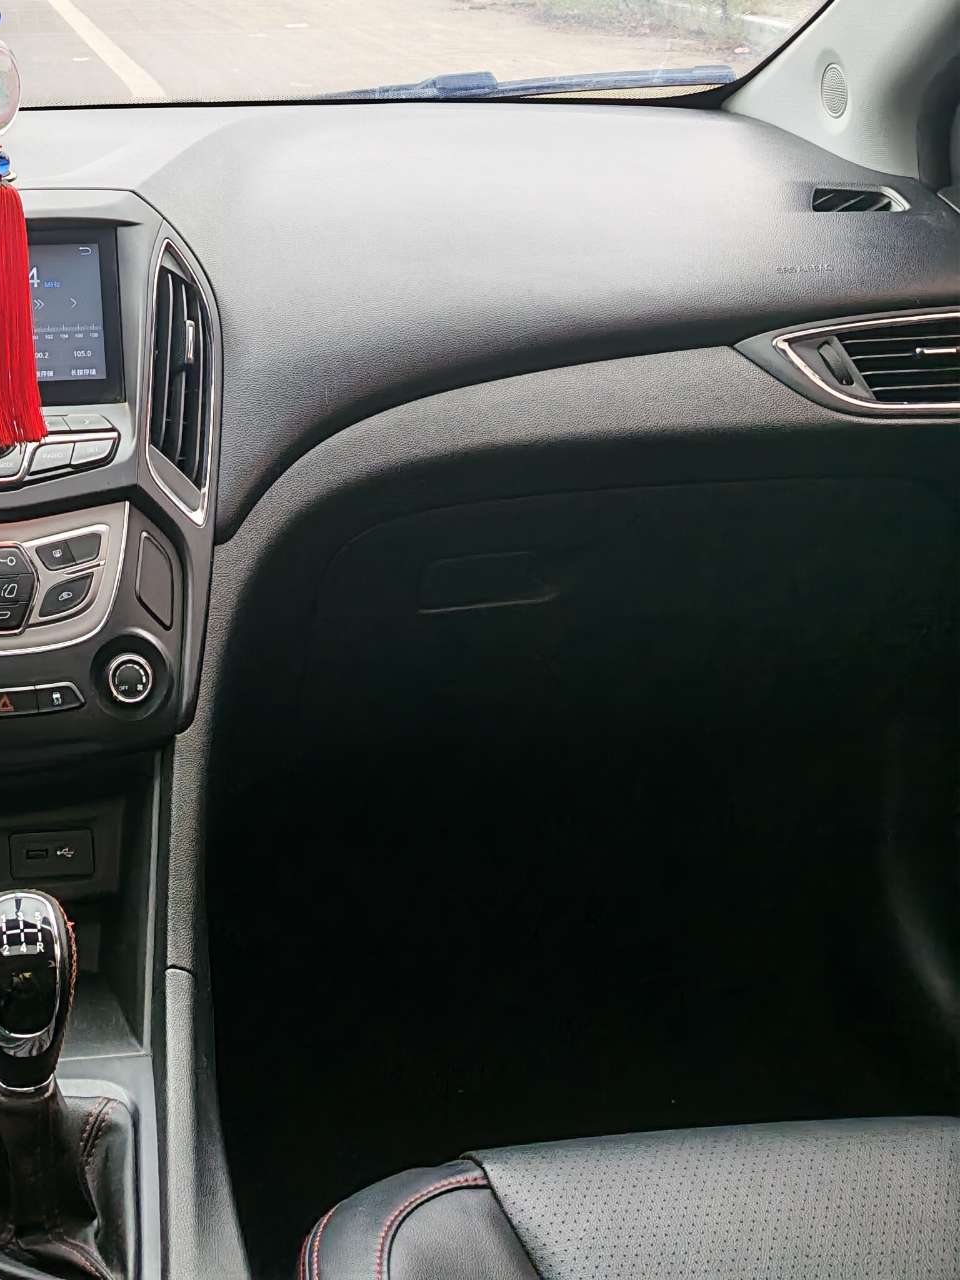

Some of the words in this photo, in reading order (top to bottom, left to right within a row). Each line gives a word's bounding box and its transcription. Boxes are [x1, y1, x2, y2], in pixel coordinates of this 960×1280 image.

[73, 350, 92, 358] 105.0
[17, 911, 24, 921] 3
[35, 911, 41, 920] 5
[2, 944, 10, 954] 2
[20, 942, 27, 953] 4
[36, 941, 45, 953] R
